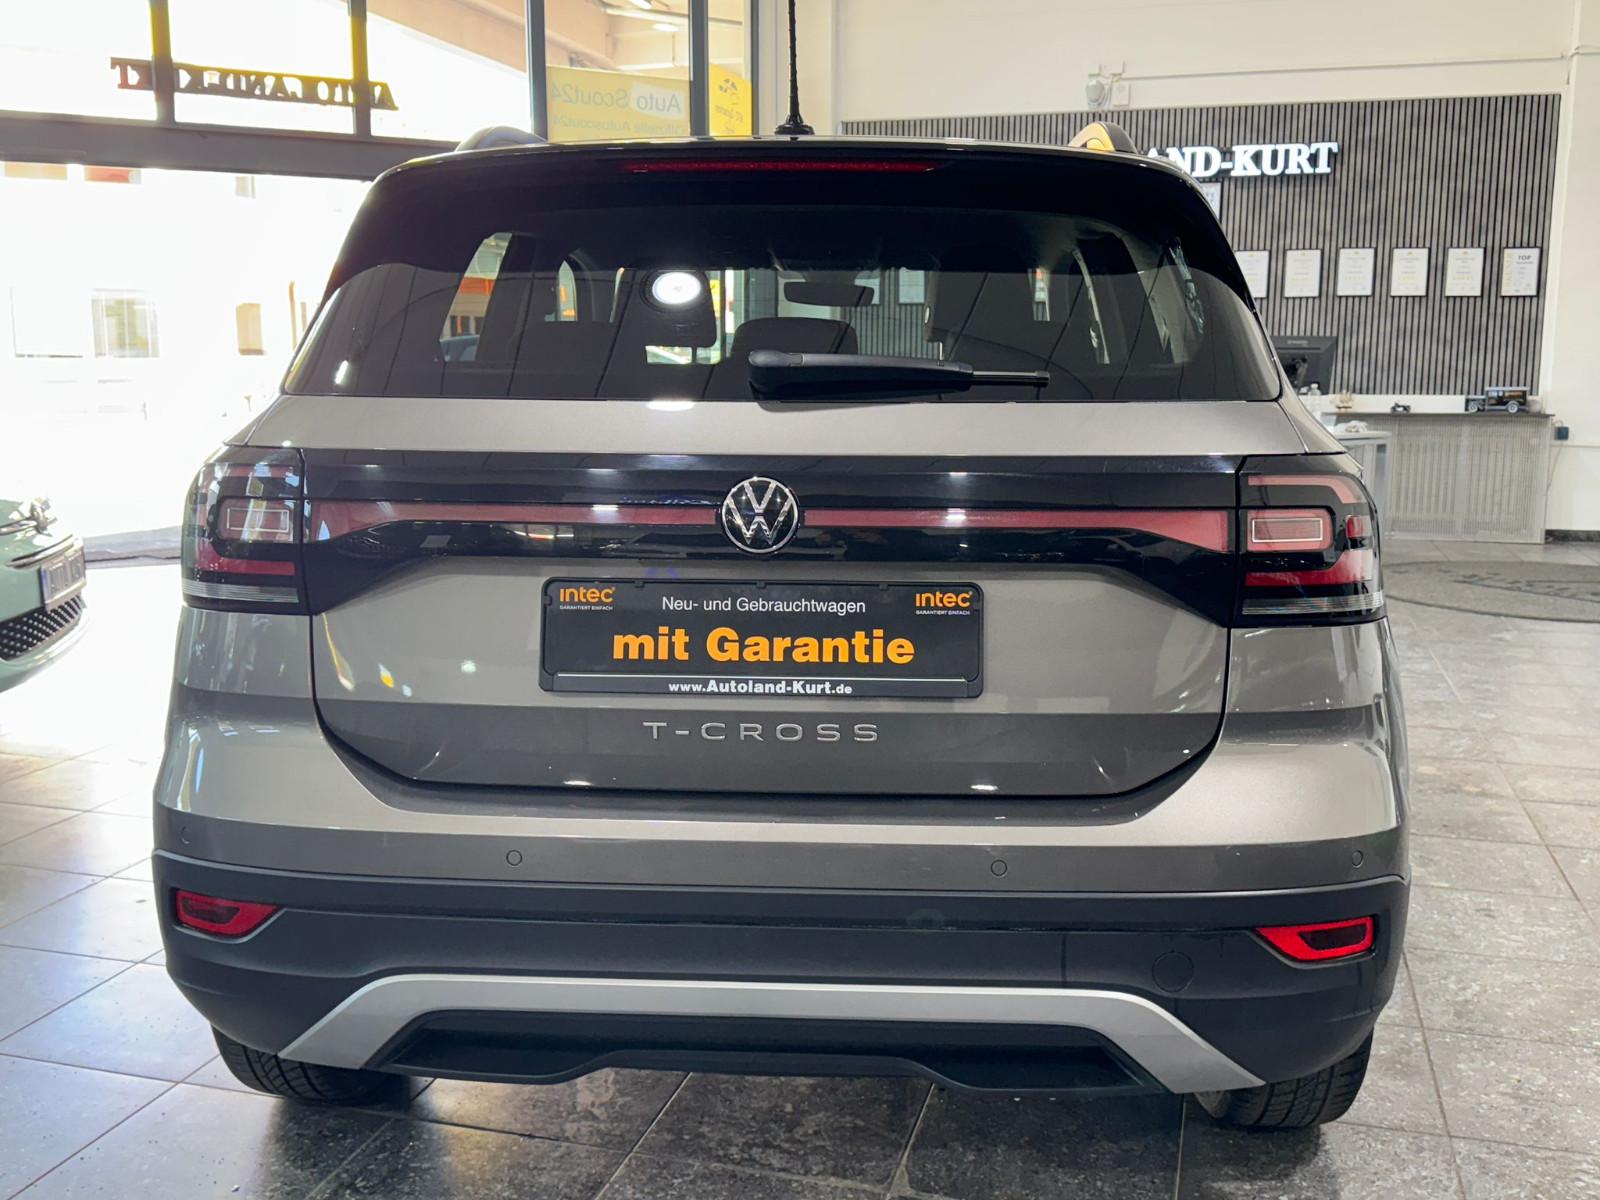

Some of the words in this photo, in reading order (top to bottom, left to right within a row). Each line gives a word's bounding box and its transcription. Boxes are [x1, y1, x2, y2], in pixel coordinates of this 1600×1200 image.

[559, 586, 614, 603] intec
[915, 591, 971, 608] intec
[662, 596, 699, 611] Neu-
[703, 597, 734, 612] und
[736, 597, 866, 616] Gebrauchtwagen
[612, 626, 690, 660] mit
[706, 627, 915, 664] Garantie
[668, 679, 853, 695] www.Autoland-Kurt.de
[642, 721, 878, 742] T-CROSS
